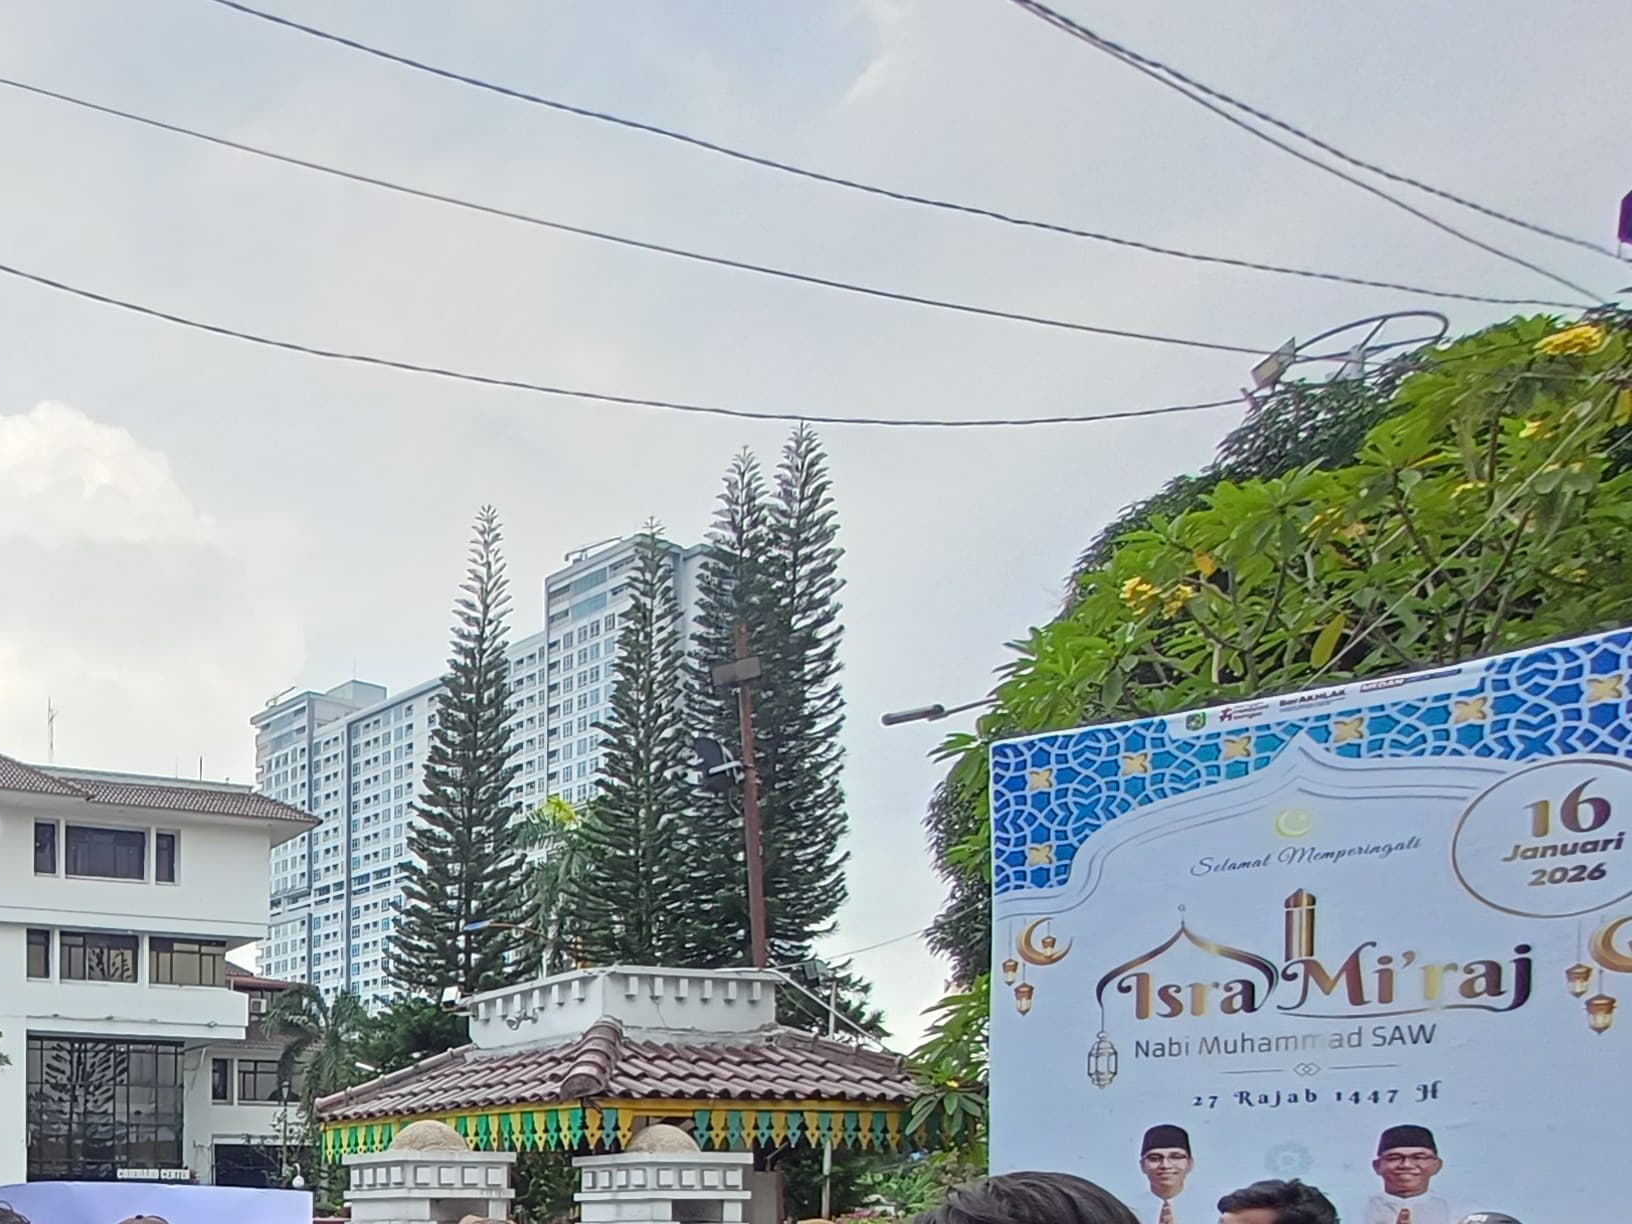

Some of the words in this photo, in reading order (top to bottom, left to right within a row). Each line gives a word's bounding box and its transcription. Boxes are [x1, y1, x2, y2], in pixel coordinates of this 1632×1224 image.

[1521, 776, 1612, 839] 16
[1190, 853, 1272, 877] Selamat
[1277, 836, 1422, 865] Memperingati
[1500, 831, 1626, 862] Januari
[1528, 861, 1608, 887] 2026
[1117, 971, 1261, 1020] Isra
[1277, 941, 1533, 1018] Mi'raj
[1134, 1037, 1190, 1058] Nabi
[1197, 1026, 1363, 1056] Muhammad
[1371, 1023, 1437, 1047] SAW
[1192, 1094, 1219, 1109] 27
[1233, 1088, 1319, 1108] Rajab
[1335, 1088, 1400, 1105] 1447
